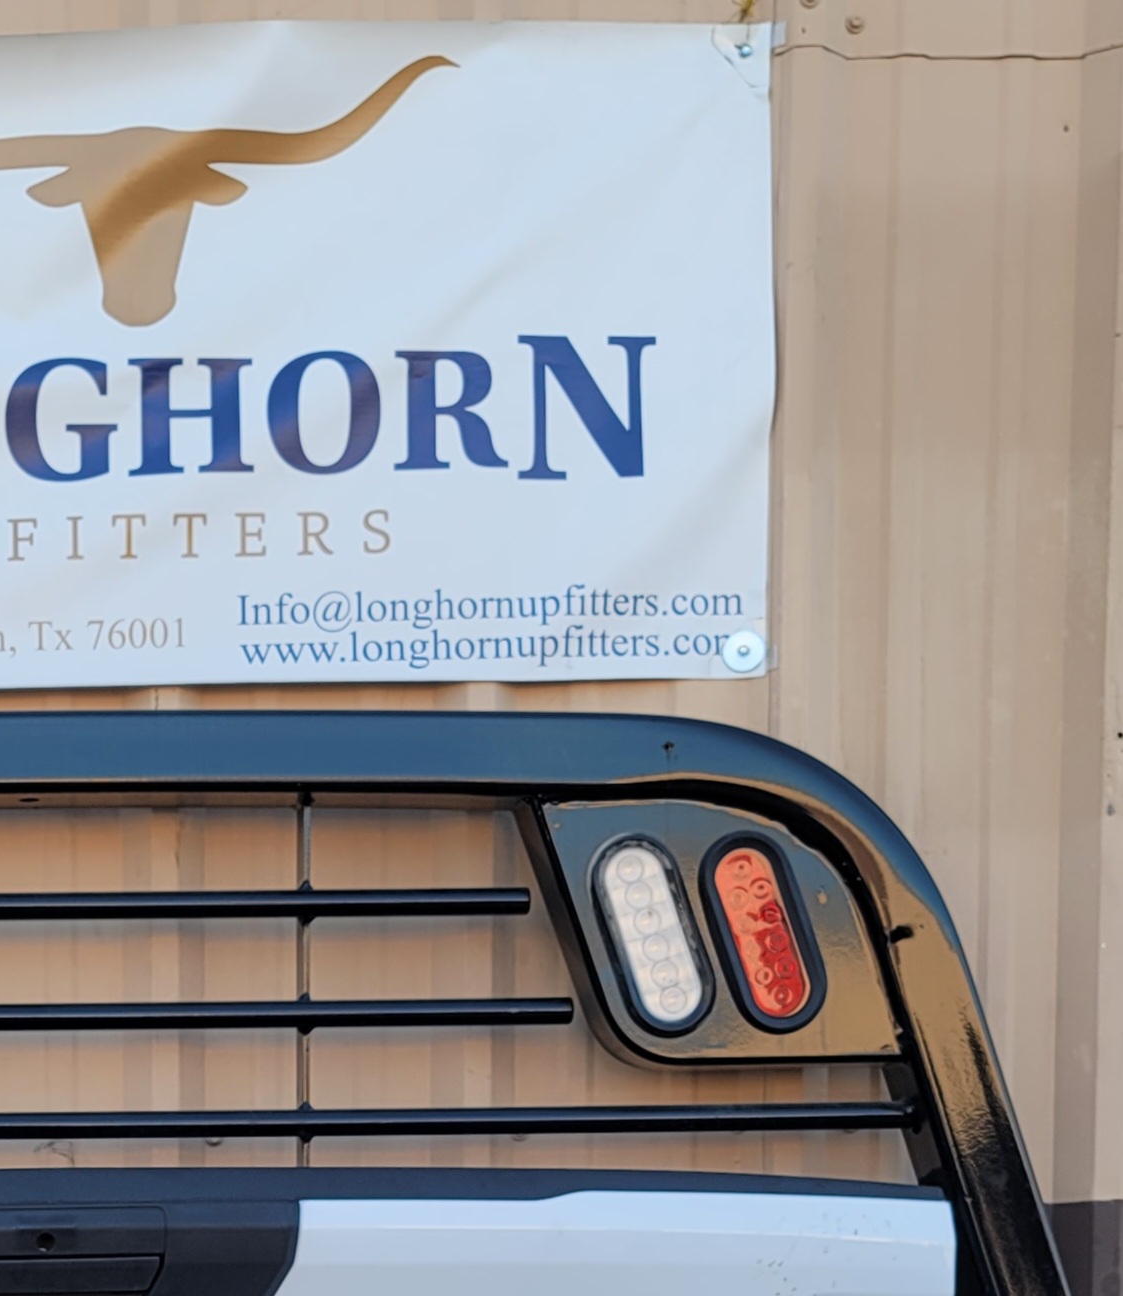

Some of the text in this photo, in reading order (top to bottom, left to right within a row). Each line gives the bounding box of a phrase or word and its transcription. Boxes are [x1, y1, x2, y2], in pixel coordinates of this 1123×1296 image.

[237, 584, 744, 630] Info@longhornupfitters.com
[28, 621, 73, 651] Tx
[87, 617, 185, 650] 76001
